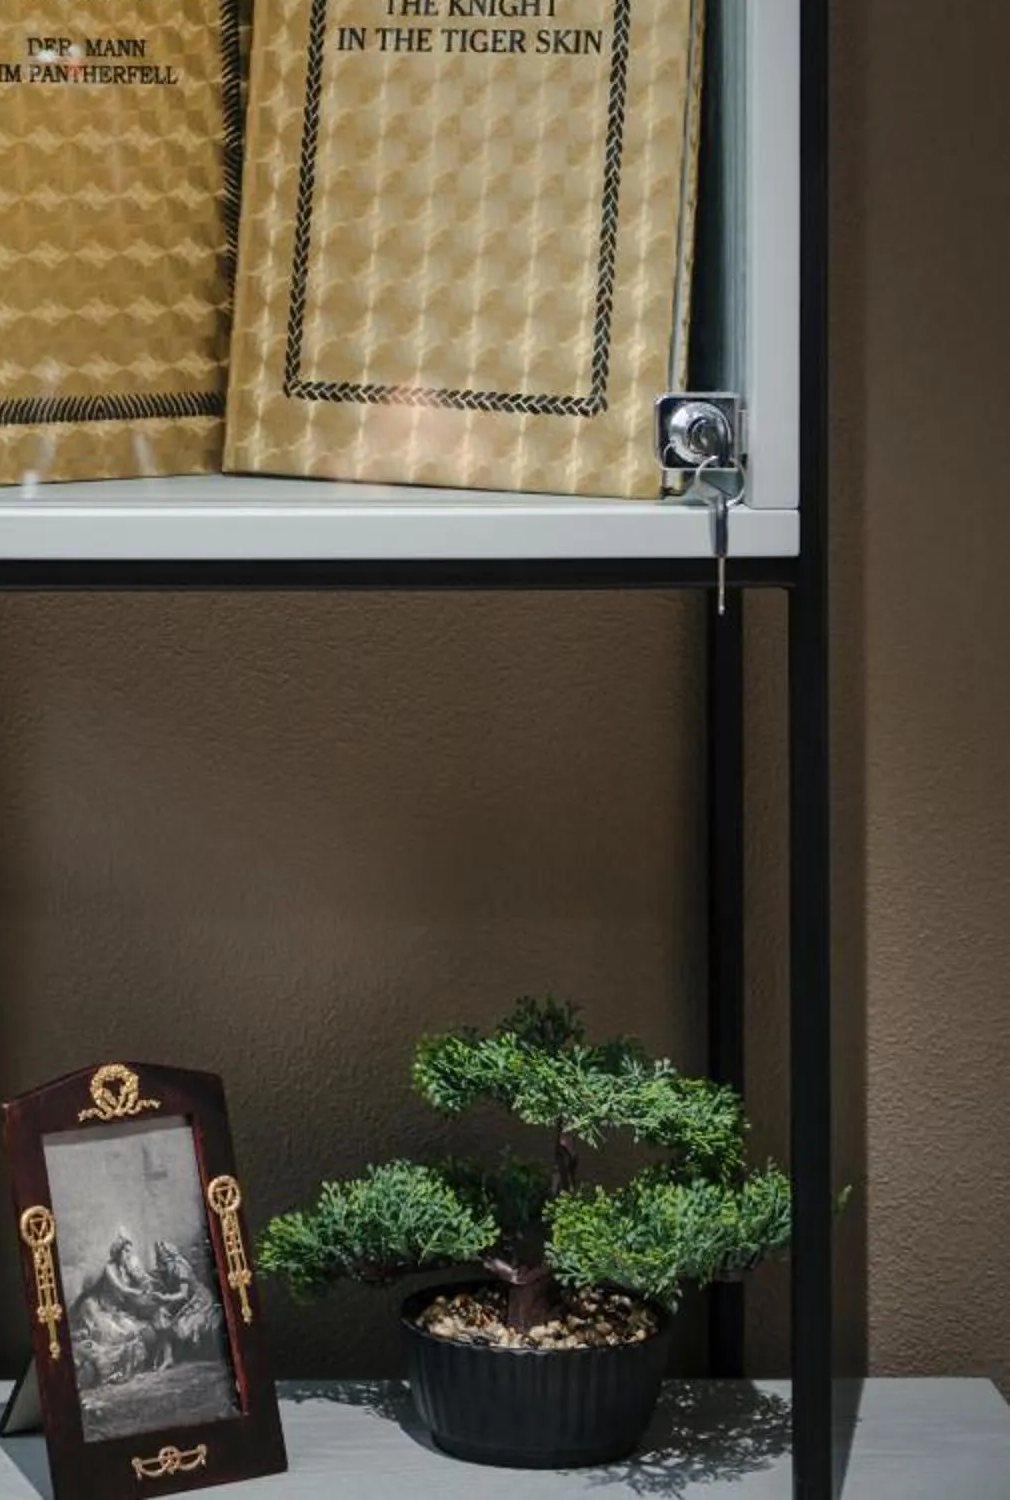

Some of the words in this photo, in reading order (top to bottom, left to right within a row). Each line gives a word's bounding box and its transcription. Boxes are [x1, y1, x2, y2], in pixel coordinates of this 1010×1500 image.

[26, 36, 75, 58] DER
[85, 38, 147, 58] MANN
[336, 27, 367, 52] IN
[375, 27, 433, 53] THE
[441, 28, 527, 54] TIGER
[534, 28, 603, 55] SKIN
[29, 63, 179, 86] PANTHERFELL
